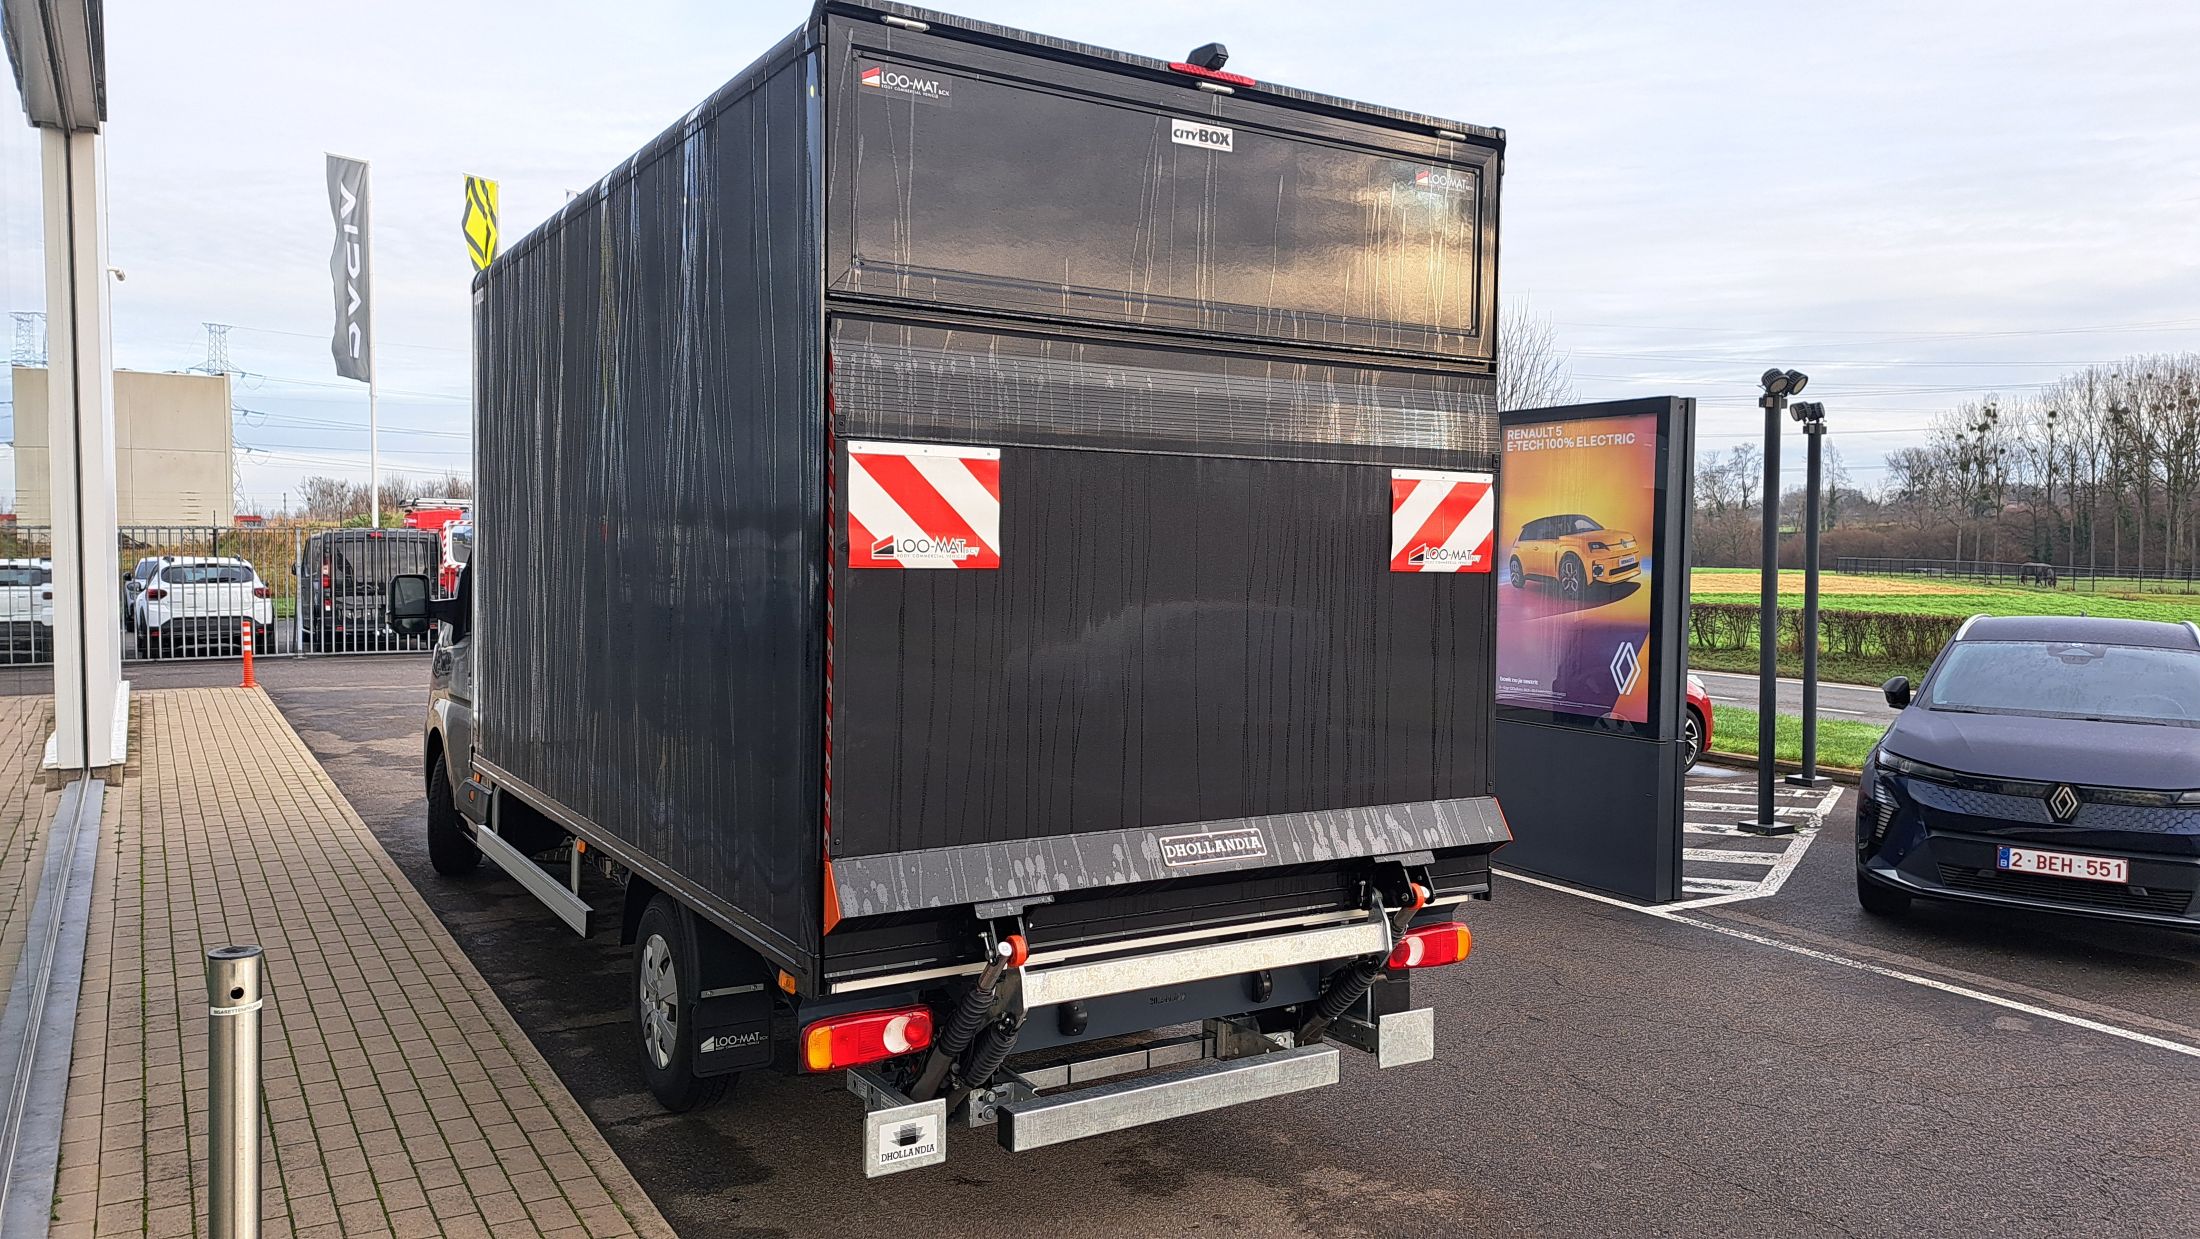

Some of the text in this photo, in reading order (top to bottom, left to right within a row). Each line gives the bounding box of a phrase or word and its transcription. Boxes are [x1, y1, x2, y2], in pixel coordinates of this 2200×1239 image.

[881, 71, 939, 94] LOO-MAT
[1507, 426, 1562, 440] RENAULT 5
[1507, 432, 1635, 452] E-TECH 100% ELECTRIC
[896, 539, 965, 554] LOO-MAT
[1425, 548, 1472, 561] LOO-MAT
[1164, 836, 1262, 858] DHOLLANDIA
[2000, 859, 2007, 867] B
[715, 1031, 760, 1048] LOO-MAT
[881, 1143, 935, 1163] DHOLLANDIA
